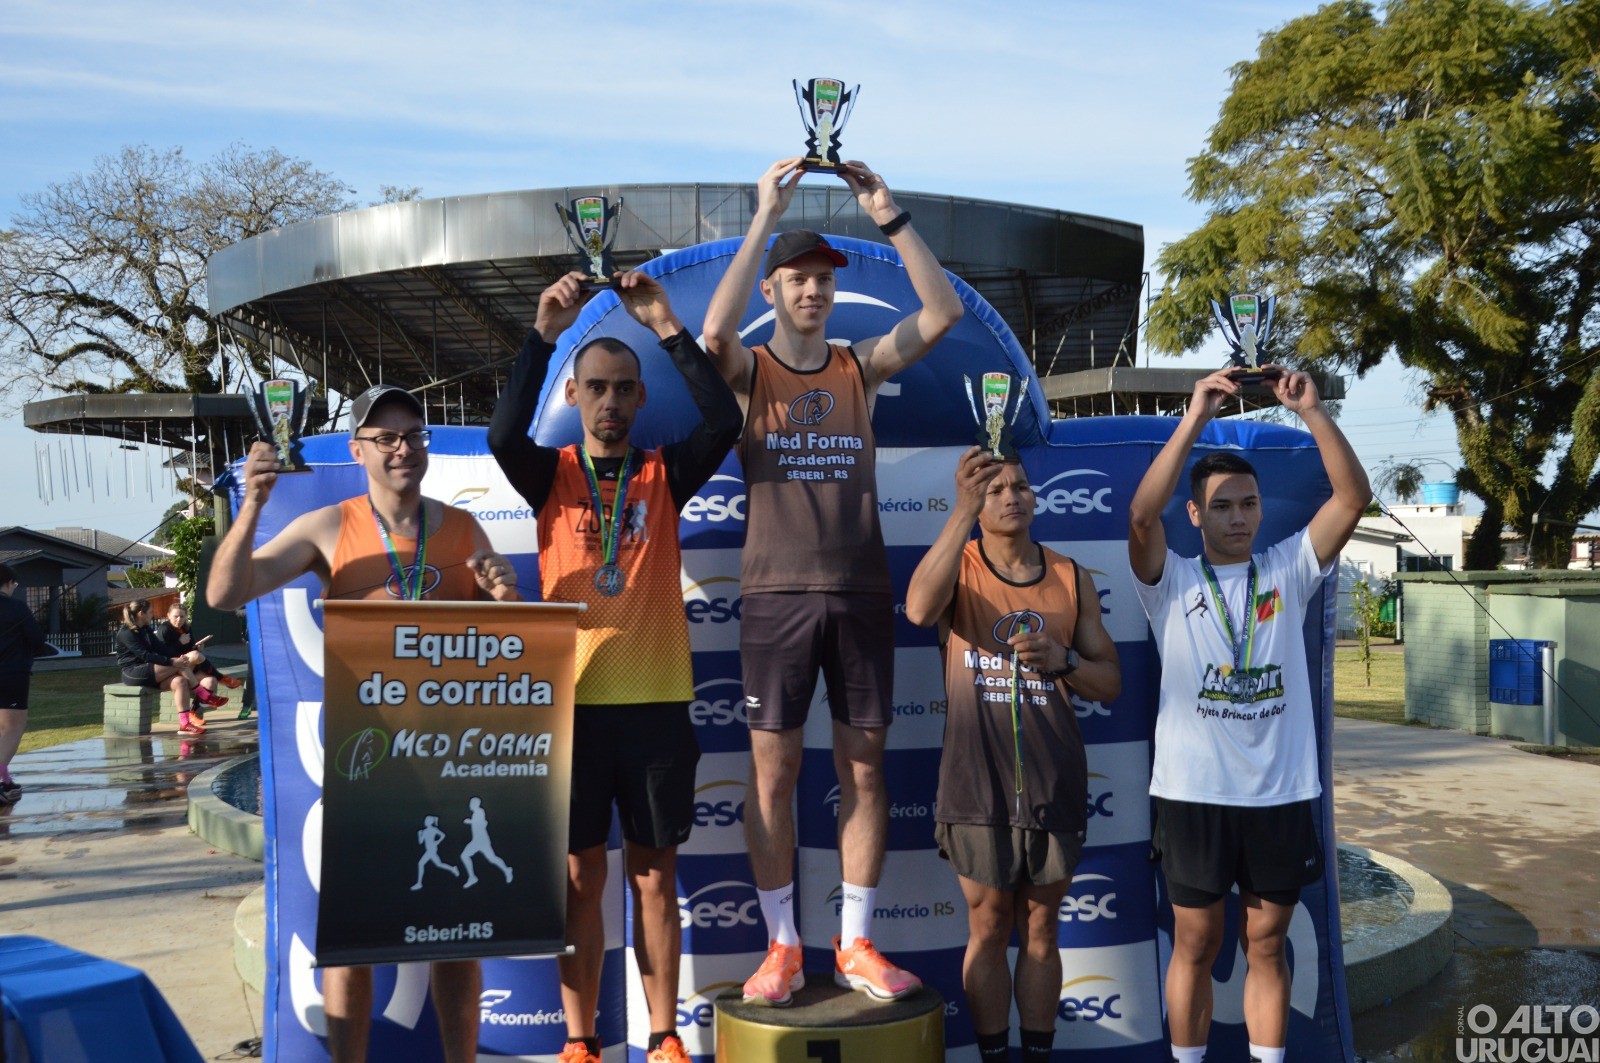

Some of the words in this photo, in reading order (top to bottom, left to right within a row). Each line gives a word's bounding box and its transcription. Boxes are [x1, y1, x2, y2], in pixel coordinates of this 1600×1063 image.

[765, 432, 802, 450] Med
[806, 431, 864, 450] Forma
[777, 452, 855, 466] Academia
[786, 470, 825, 480] SEBERI
[834, 469, 849, 480] RS
[680, 494, 746, 522] esc
[927, 498, 949, 512] RS
[394, 625, 524, 667] Equipe
[964, 650, 1003, 670] Med
[358, 672, 407, 705] de
[417, 672, 554, 706] corrida
[983, 692, 1024, 704] SEBEI
[1032, 695, 1048, 706] RS
[1259, 707, 1270, 719] de
[440, 760, 548, 778] Academia
[934, 902, 955, 916] RS
[1058, 892, 1117, 922] esc
[404, 921, 494, 943] Seberi-RS
[1057, 993, 1122, 1022] esc
